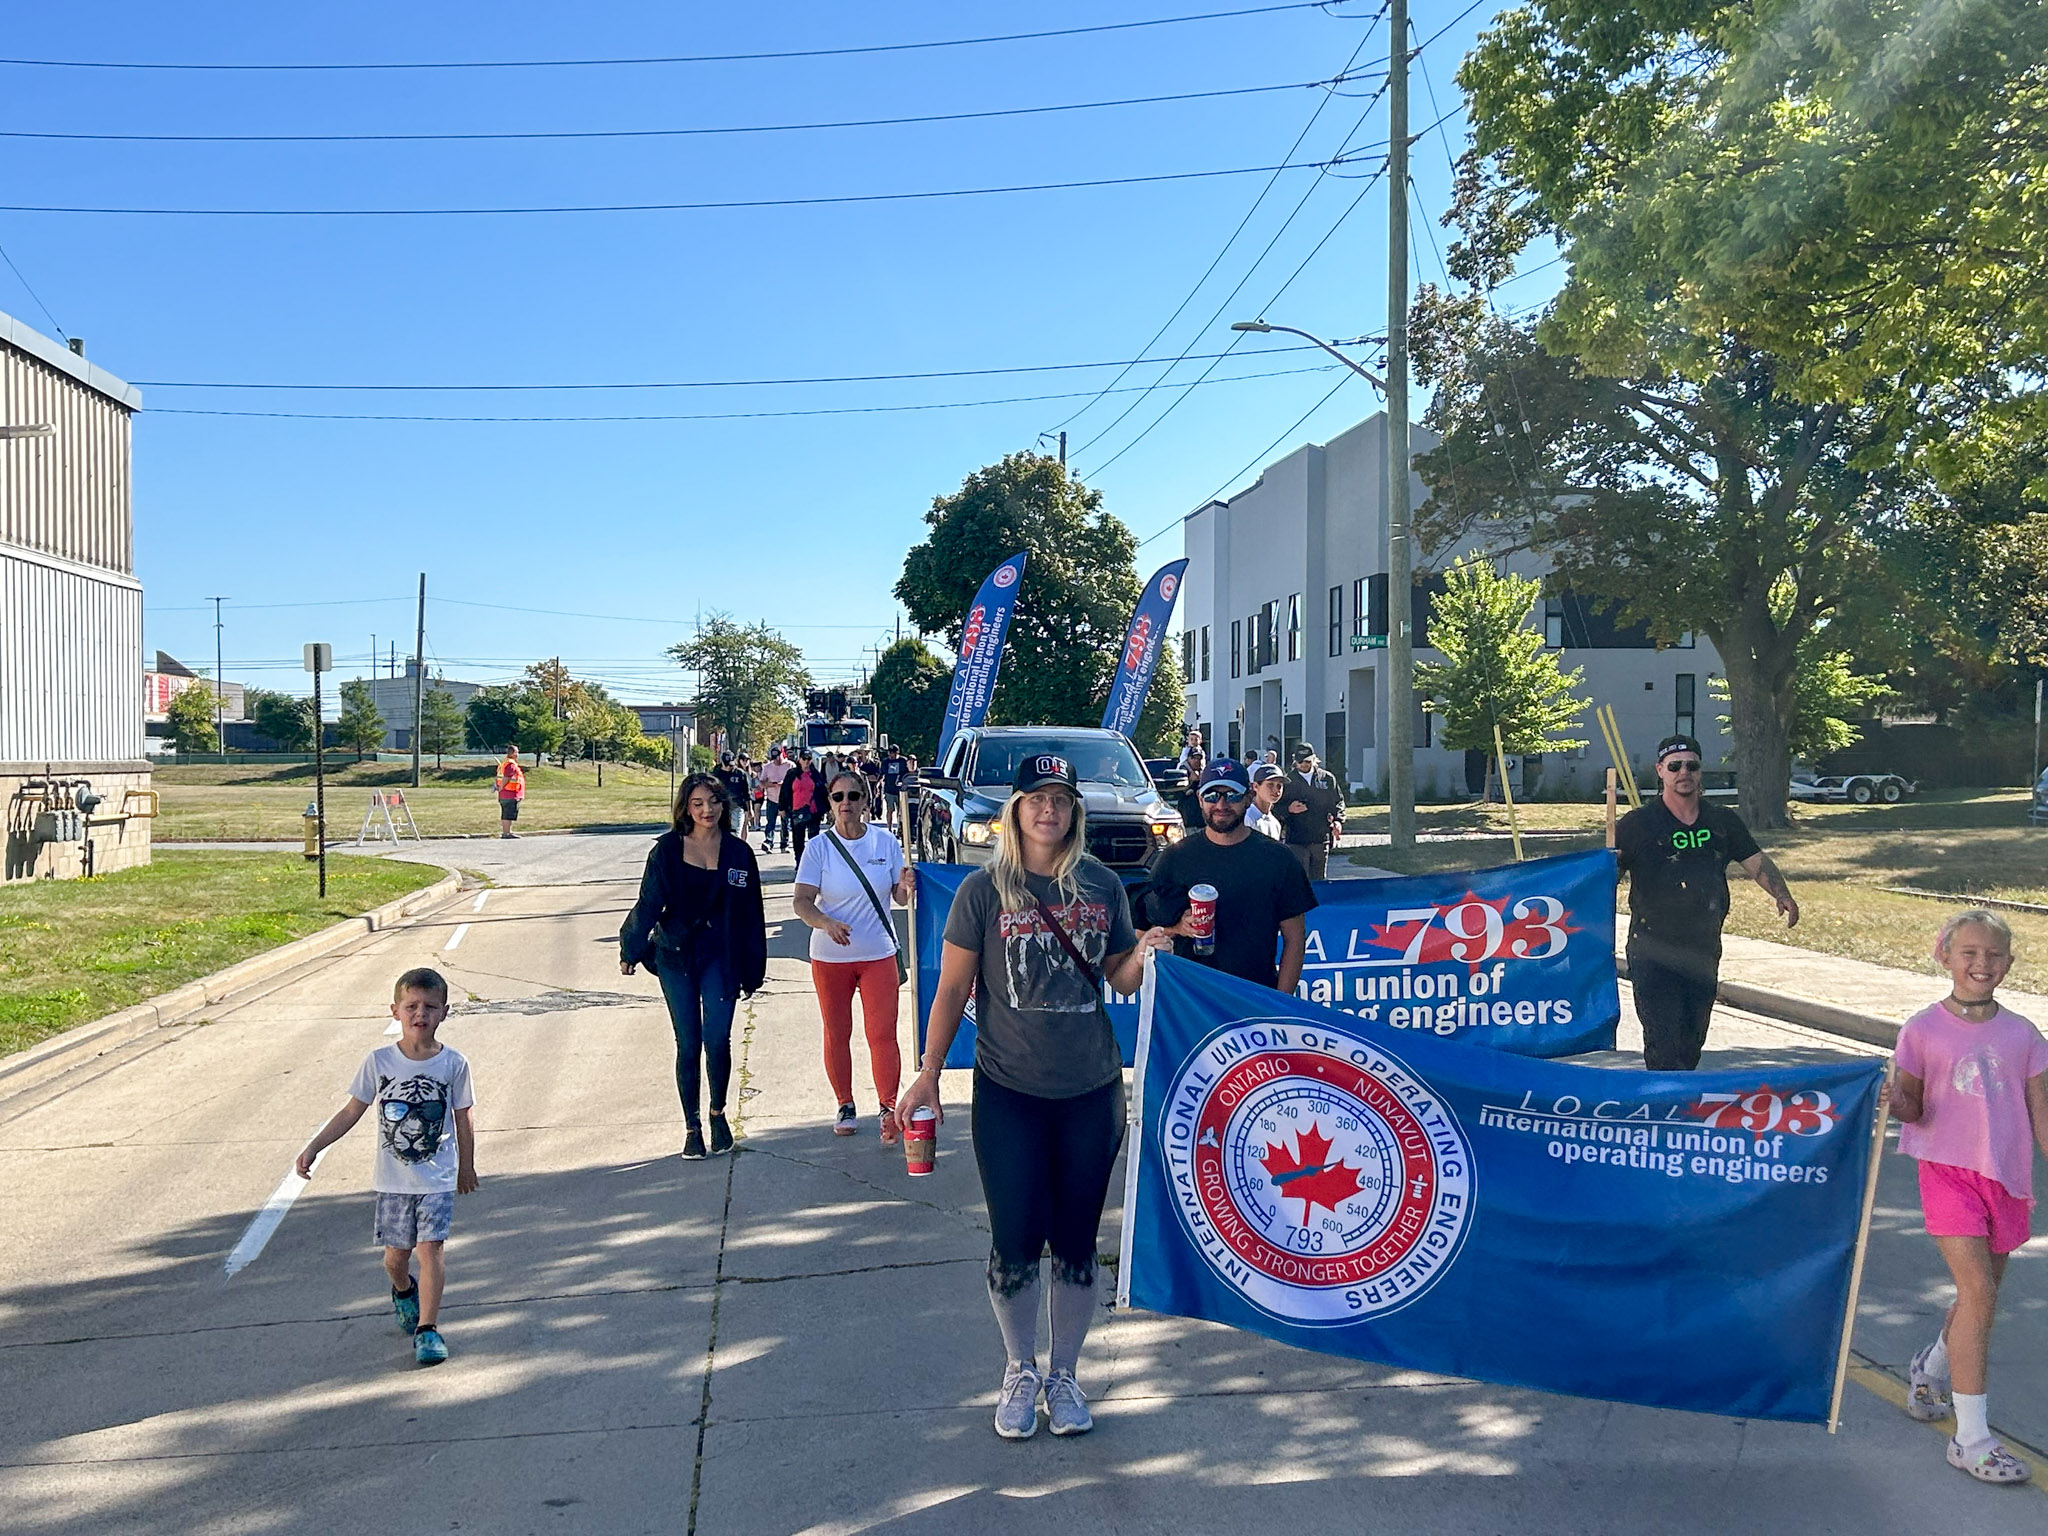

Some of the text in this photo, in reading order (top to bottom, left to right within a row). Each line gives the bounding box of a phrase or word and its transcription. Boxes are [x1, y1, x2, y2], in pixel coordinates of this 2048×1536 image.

[974, 635, 988, 663] union
[982, 622, 991, 633] of
[974, 606, 1006, 708] operating engineers
[1125, 614, 1152, 667] 793
[1351, 636, 1377, 645] DURHAM
[949, 605, 986, 718] LOCAL 793
[1036, 756, 1069, 780] OE
[1672, 828, 1712, 849] GIP
[1190, 902, 1207, 915] Tim
[1386, 895, 1569, 964] 793
[1354, 967, 1459, 1001] union
[1468, 962, 1506, 995] of
[1388, 998, 1574, 1036] engineers
[1210, 1027, 1290, 1065] UNION
[1301, 1032, 1339, 1052] OF
[1218, 1056, 1291, 1108] ONTARIO
[1276, 1103, 1299, 1120] 240
[1307, 1100, 1330, 1115] 300
[1335, 1116, 1359, 1132] 360
[1349, 1048, 1464, 1179] OPERATING
[1353, 1077, 1428, 1163] NUNAVUT
[1519, 1090, 1835, 1137] LOCAL 793
[1258, 1117, 1277, 1133] 180
[1479, 1108, 1784, 1159] international union of
[1246, 1144, 1266, 1159] 120
[1354, 1144, 1378, 1159] 420
[1547, 1138, 1829, 1184] operating engineers
[1171, 1069, 1252, 1288] INTERNATIONAL
[1249, 1177, 1264, 1191] 60
[1358, 1175, 1382, 1191] 480
[1202, 1159, 1424, 1282] GROWING STRONGER TOGETHER
[1268, 1203, 1277, 1217] 0
[1321, 1217, 1344, 1234] 600
[1346, 1202, 1370, 1219] 540
[1285, 1224, 1324, 1252] 793
[1345, 1191, 1462, 1311] ENGINEERS
